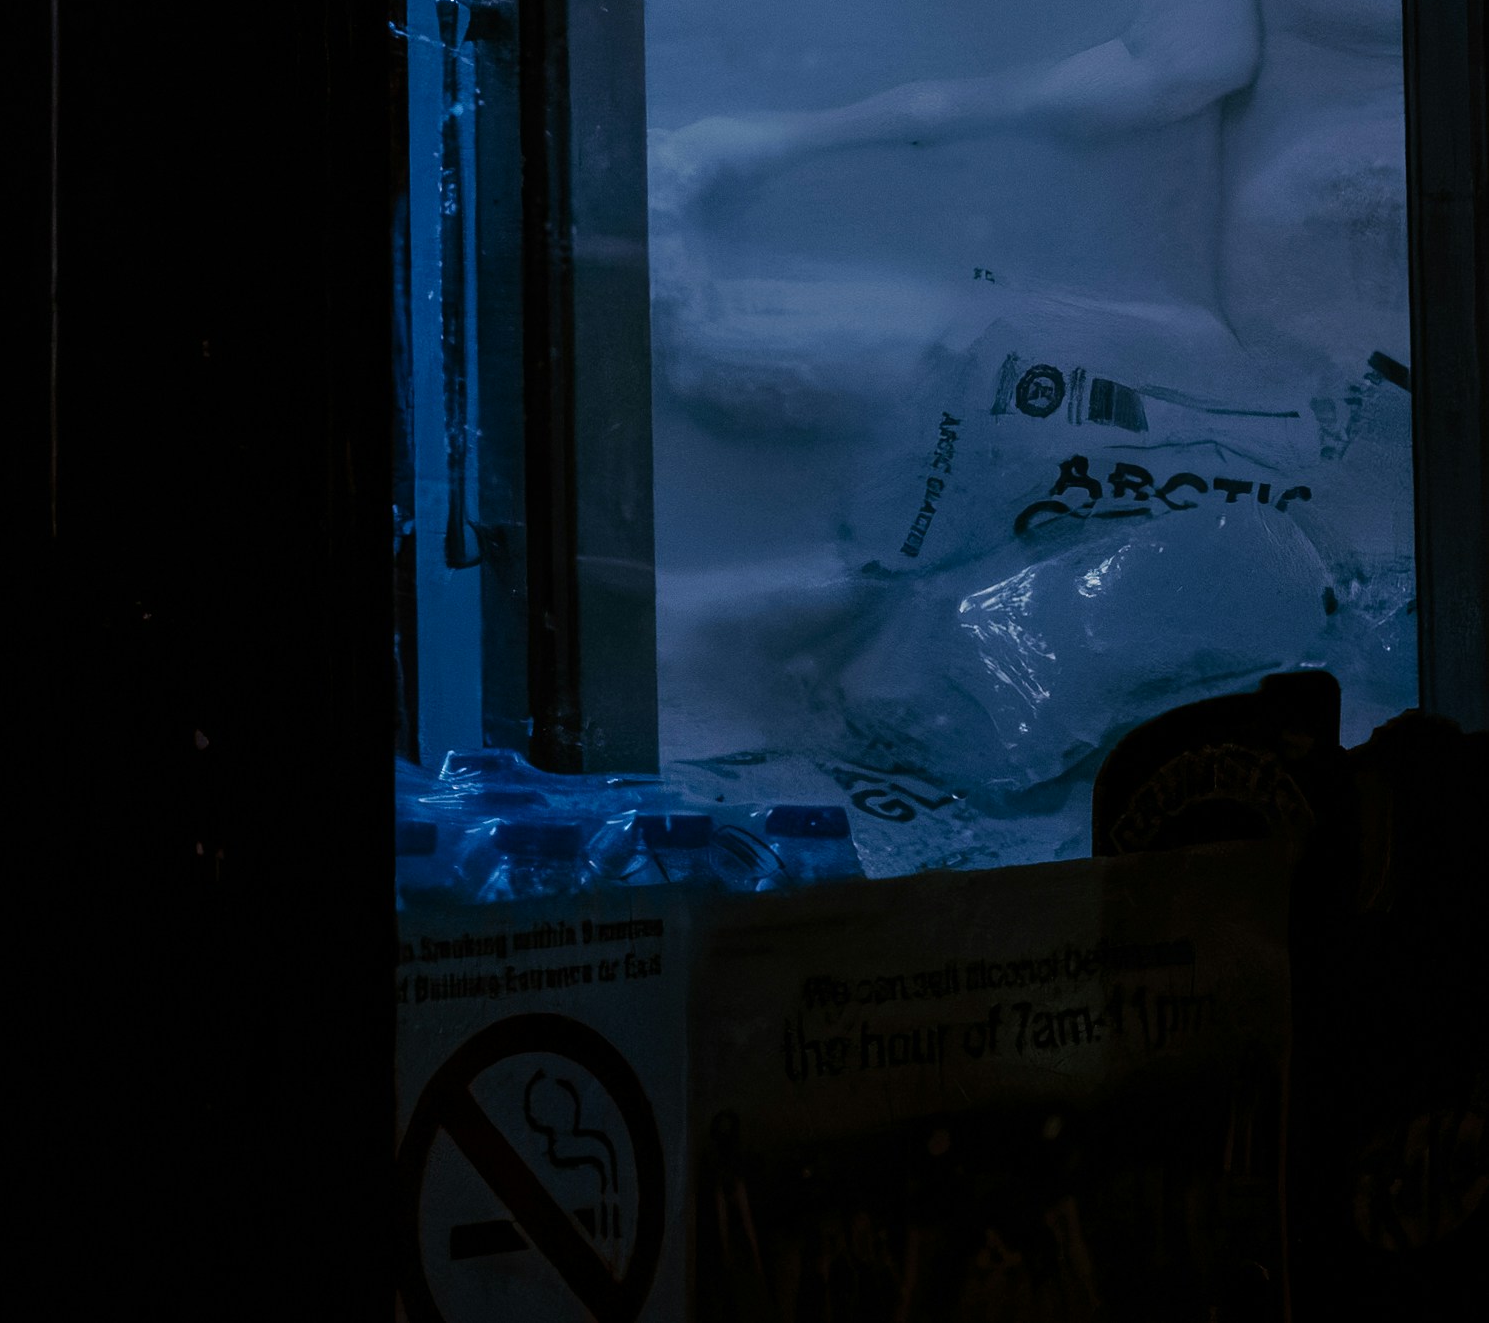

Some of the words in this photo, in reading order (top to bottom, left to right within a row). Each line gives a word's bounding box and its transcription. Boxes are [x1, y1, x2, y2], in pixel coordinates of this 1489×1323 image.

[784, 1018, 849, 1084] the
[861, 1015, 946, 1073] hour
[962, 1001, 1003, 1058] of
